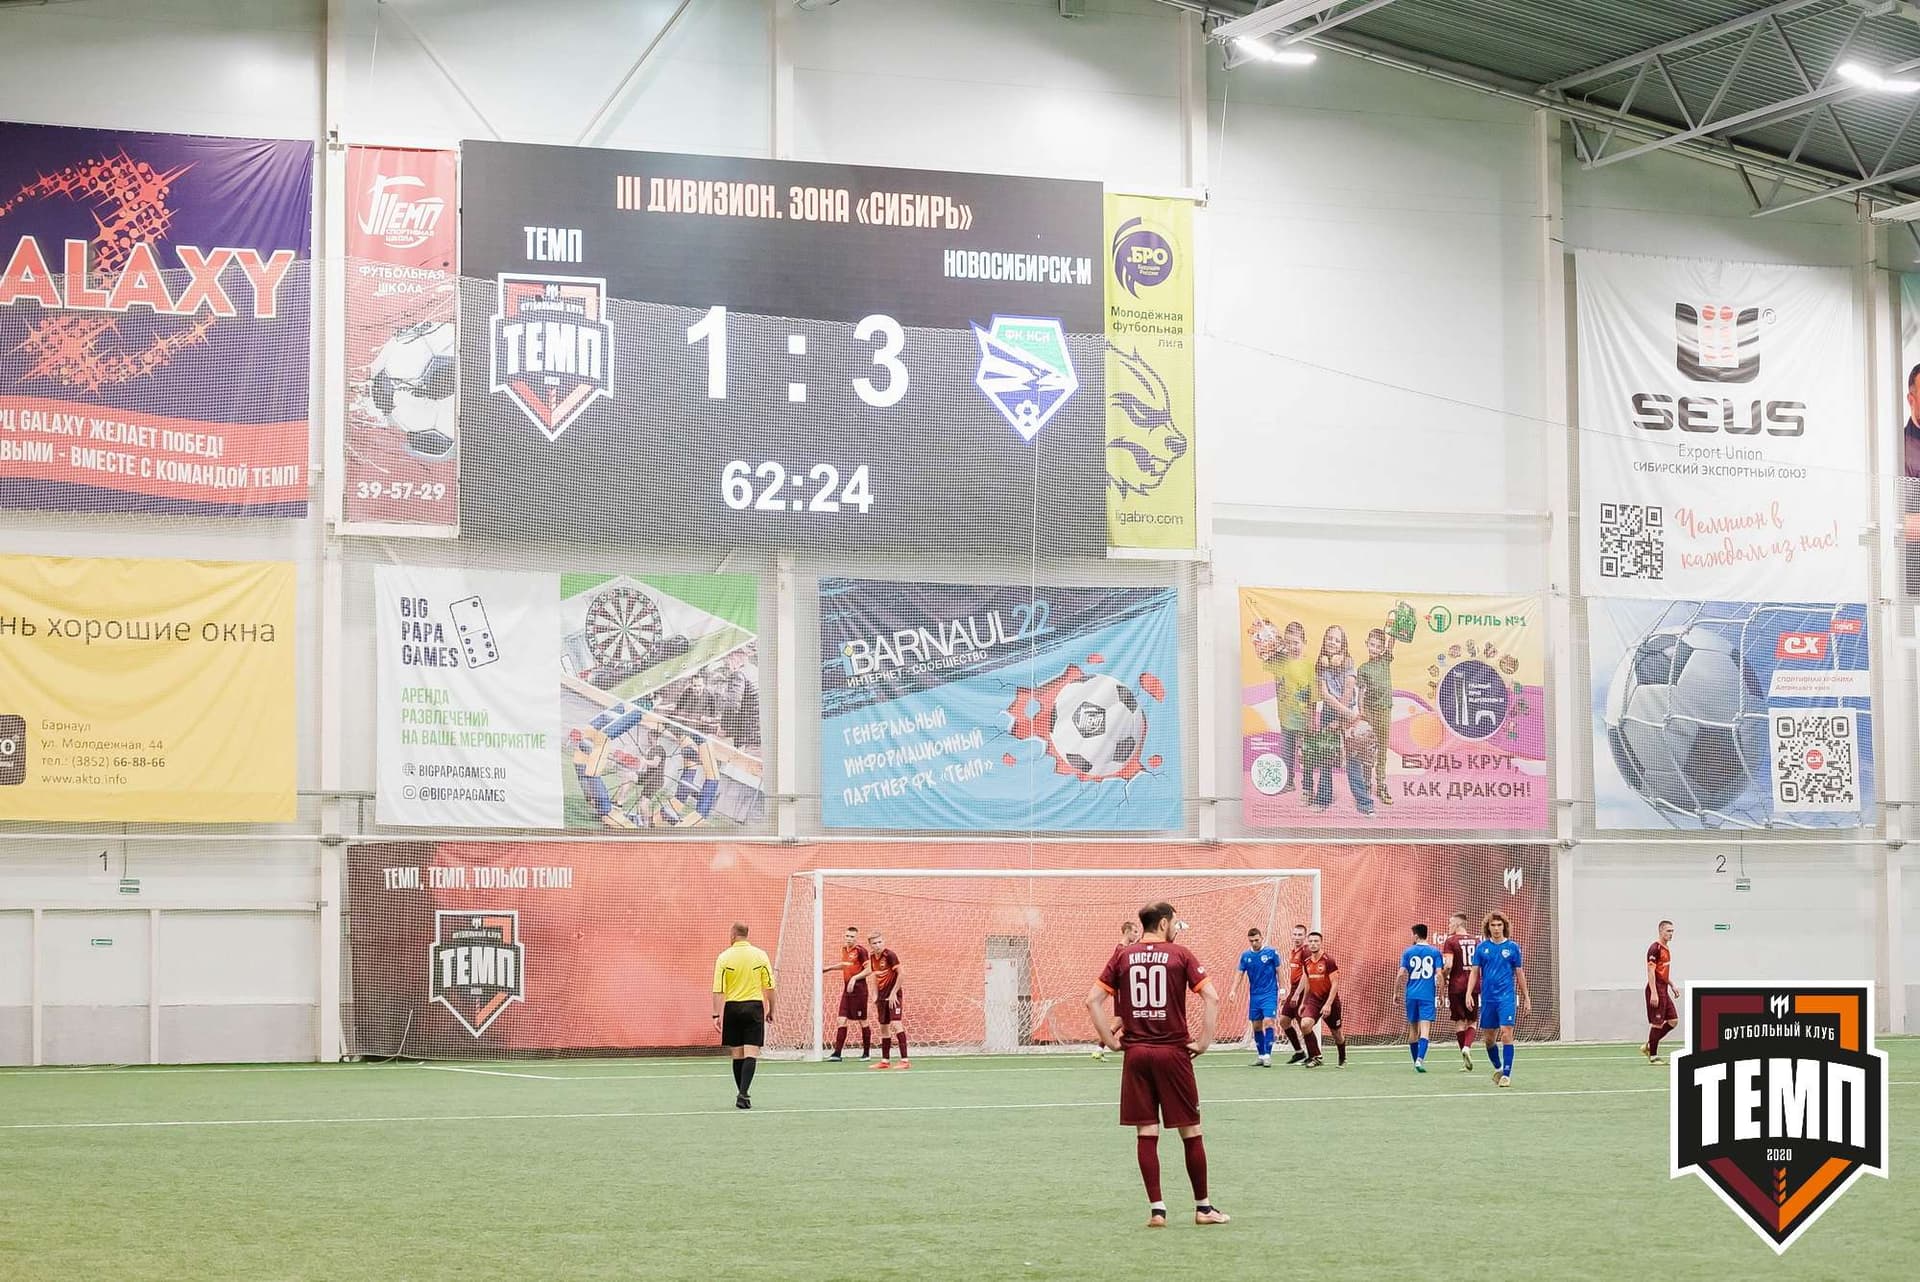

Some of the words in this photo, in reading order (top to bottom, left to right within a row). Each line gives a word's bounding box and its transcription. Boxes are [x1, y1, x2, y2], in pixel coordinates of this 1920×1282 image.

[616, 175, 641, 211] III
[648, 178, 782, 219] ДИВИЗИОН.
[789, 187, 850, 223] ЗОНА
[855, 191, 973, 231] «СИБИРЬ»
[524, 226, 583, 263] ТЕМП
[359, 265, 445, 280] ФУТБОЛЬНАЯ
[944, 249, 1092, 285] НОВОСИБИРСК-М
[377, 282, 423, 294] ШКОЛА
[1111, 306, 1183, 321] Молодёжная
[1113, 320, 1183, 335] футбольная
[503, 322, 600, 379] ТЕМП
[1159, 339, 1183, 349] лига
[687, 306, 727, 399] 1
[852, 314, 909, 407] 3
[1631, 393, 1807, 437] SEUS
[20, 409, 83, 436] GALAXY
[90, 419, 158, 449] ЖЕЛАЕТ
[163, 429, 223, 458] ПОБЕД!
[1678, 443, 1721, 460] Export
[1726, 445, 1763, 461] Union
[71, 446, 136, 476] ВМЕСТЕ
[141, 457, 150, 478] С
[157, 460, 247, 488] КОМАНДОЙ
[253, 465, 299, 487] ТЕМП!
[1633, 461, 1698, 475] СИБИРСКИЙ
[1702, 464, 1775, 478] ЭКСПОРТНЫЙ
[1778, 468, 1807, 479] СОЮЗ
[357, 481, 446, 500] 39-57-29
[721, 460, 874, 513] 62:24
[1675, 507, 1768, 539] Чемпион
[1681, 536, 1768, 569] каждом
[1773, 540, 1796, 562] из
[1799, 519, 1839, 551] нас!
[400, 596, 428, 619] BIG
[47, 616, 191, 645] хорошие
[202, 621, 275, 643] окна
[1458, 614, 1501, 626] ГРИЛЬ
[401, 620, 445, 643] PAPA
[402, 644, 459, 668] GAMES
[401, 687, 450, 706] АРЕНДА
[41, 718, 91, 732] Барнаул
[401, 708, 489, 727] РАЗВЛЕЧЕНИЙ
[843, 706, 947, 747] ГЕНЕРАЛЬНЫЙ
[149, 740, 163, 749] 44
[401, 728, 418, 745] НА
[422, 729, 457, 747] ВАШЕ
[460, 731, 546, 749] МЕРОПРИЯТИЕ
[72, 756, 109, 768] (3852)
[113, 757, 165, 768] 66-88-66
[844, 727, 984, 778] ИНФОРМАЦИОННЫЙ
[1401, 753, 1462, 773] БУДЬ
[1467, 754, 1519, 773] КРУТ,
[41, 773, 128, 785] www.akto.info
[419, 764, 506, 780] BIGPAPAGAMES.RU
[419, 785, 506, 803] @BIGPAPAGAMES
[844, 778, 908, 807] ПАРТНЕР
[911, 769, 937, 791] ФК
[1403, 781, 1441, 797] КАК
[1446, 781, 1531, 800] ДРАКОН!
[99, 850, 108, 872] 1
[1716, 854, 1727, 873] 2
[383, 867, 424, 890] ТЕМП,
[428, 867, 470, 890] ТЕМП,
[473, 867, 528, 889] ТОЛЬКО
[532, 867, 572, 889] ТЕМП!
[440, 946, 515, 988] ТЕМП
[1409, 956, 1434, 979] 28
[1129, 965, 1168, 1008] 60
[1133, 1010, 1166, 1018] SEUS
